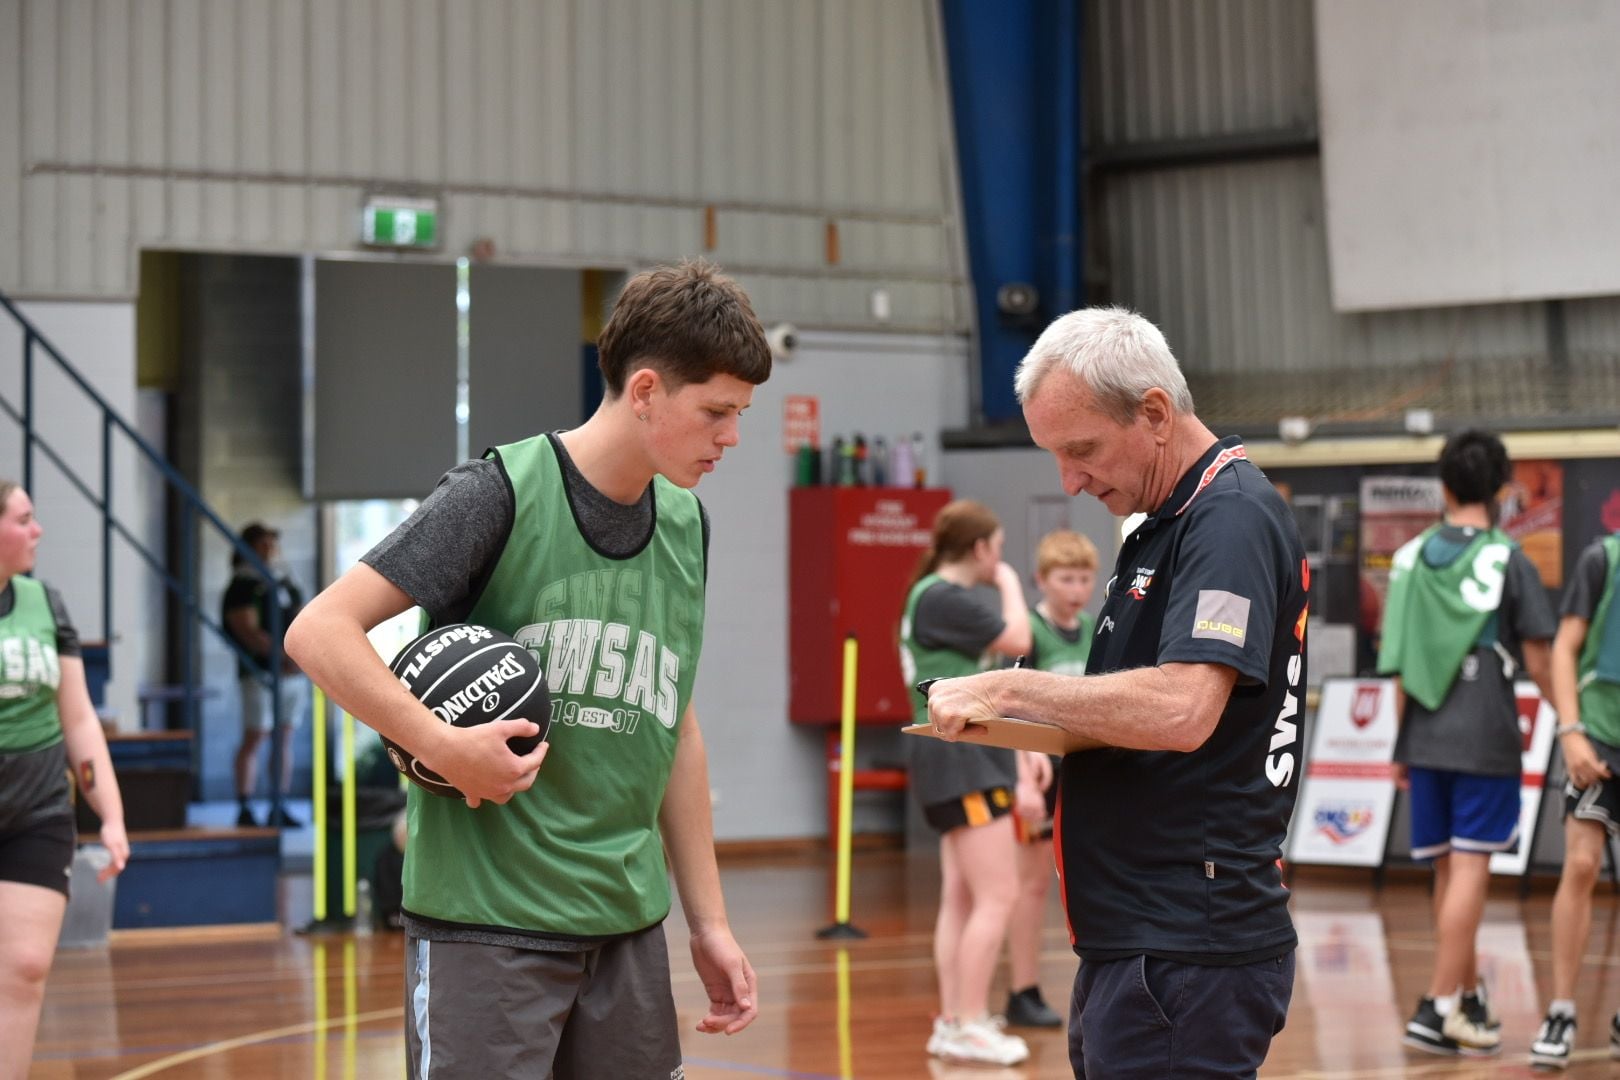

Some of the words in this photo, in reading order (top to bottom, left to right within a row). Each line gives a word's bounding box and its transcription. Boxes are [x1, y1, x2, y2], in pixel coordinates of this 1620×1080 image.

[1196, 619, 1244, 638] QUBE
[550, 698, 580, 727] 19
[581, 710, 609, 725] EST
[610, 708, 641, 735] 97
